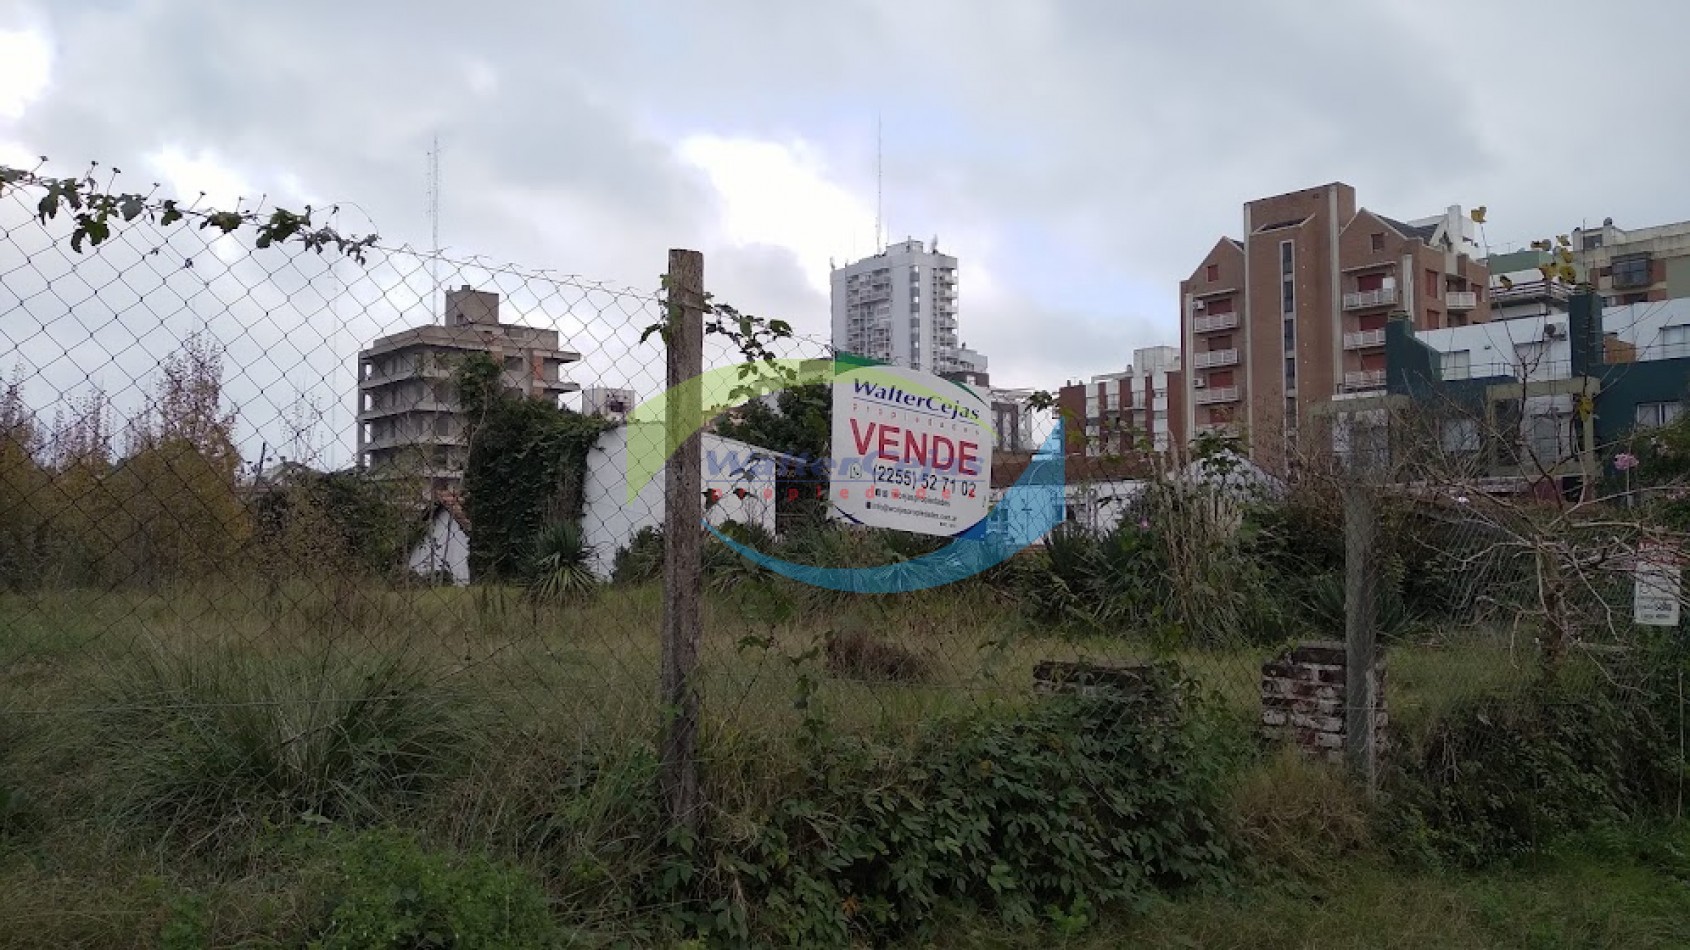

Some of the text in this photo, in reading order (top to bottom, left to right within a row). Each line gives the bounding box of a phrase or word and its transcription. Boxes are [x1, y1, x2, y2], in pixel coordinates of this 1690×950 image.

[853, 378, 980, 420] WalterCejas
[850, 418, 978, 477] VENDE
[873, 464, 977, 498] (2255) 52 71 02
